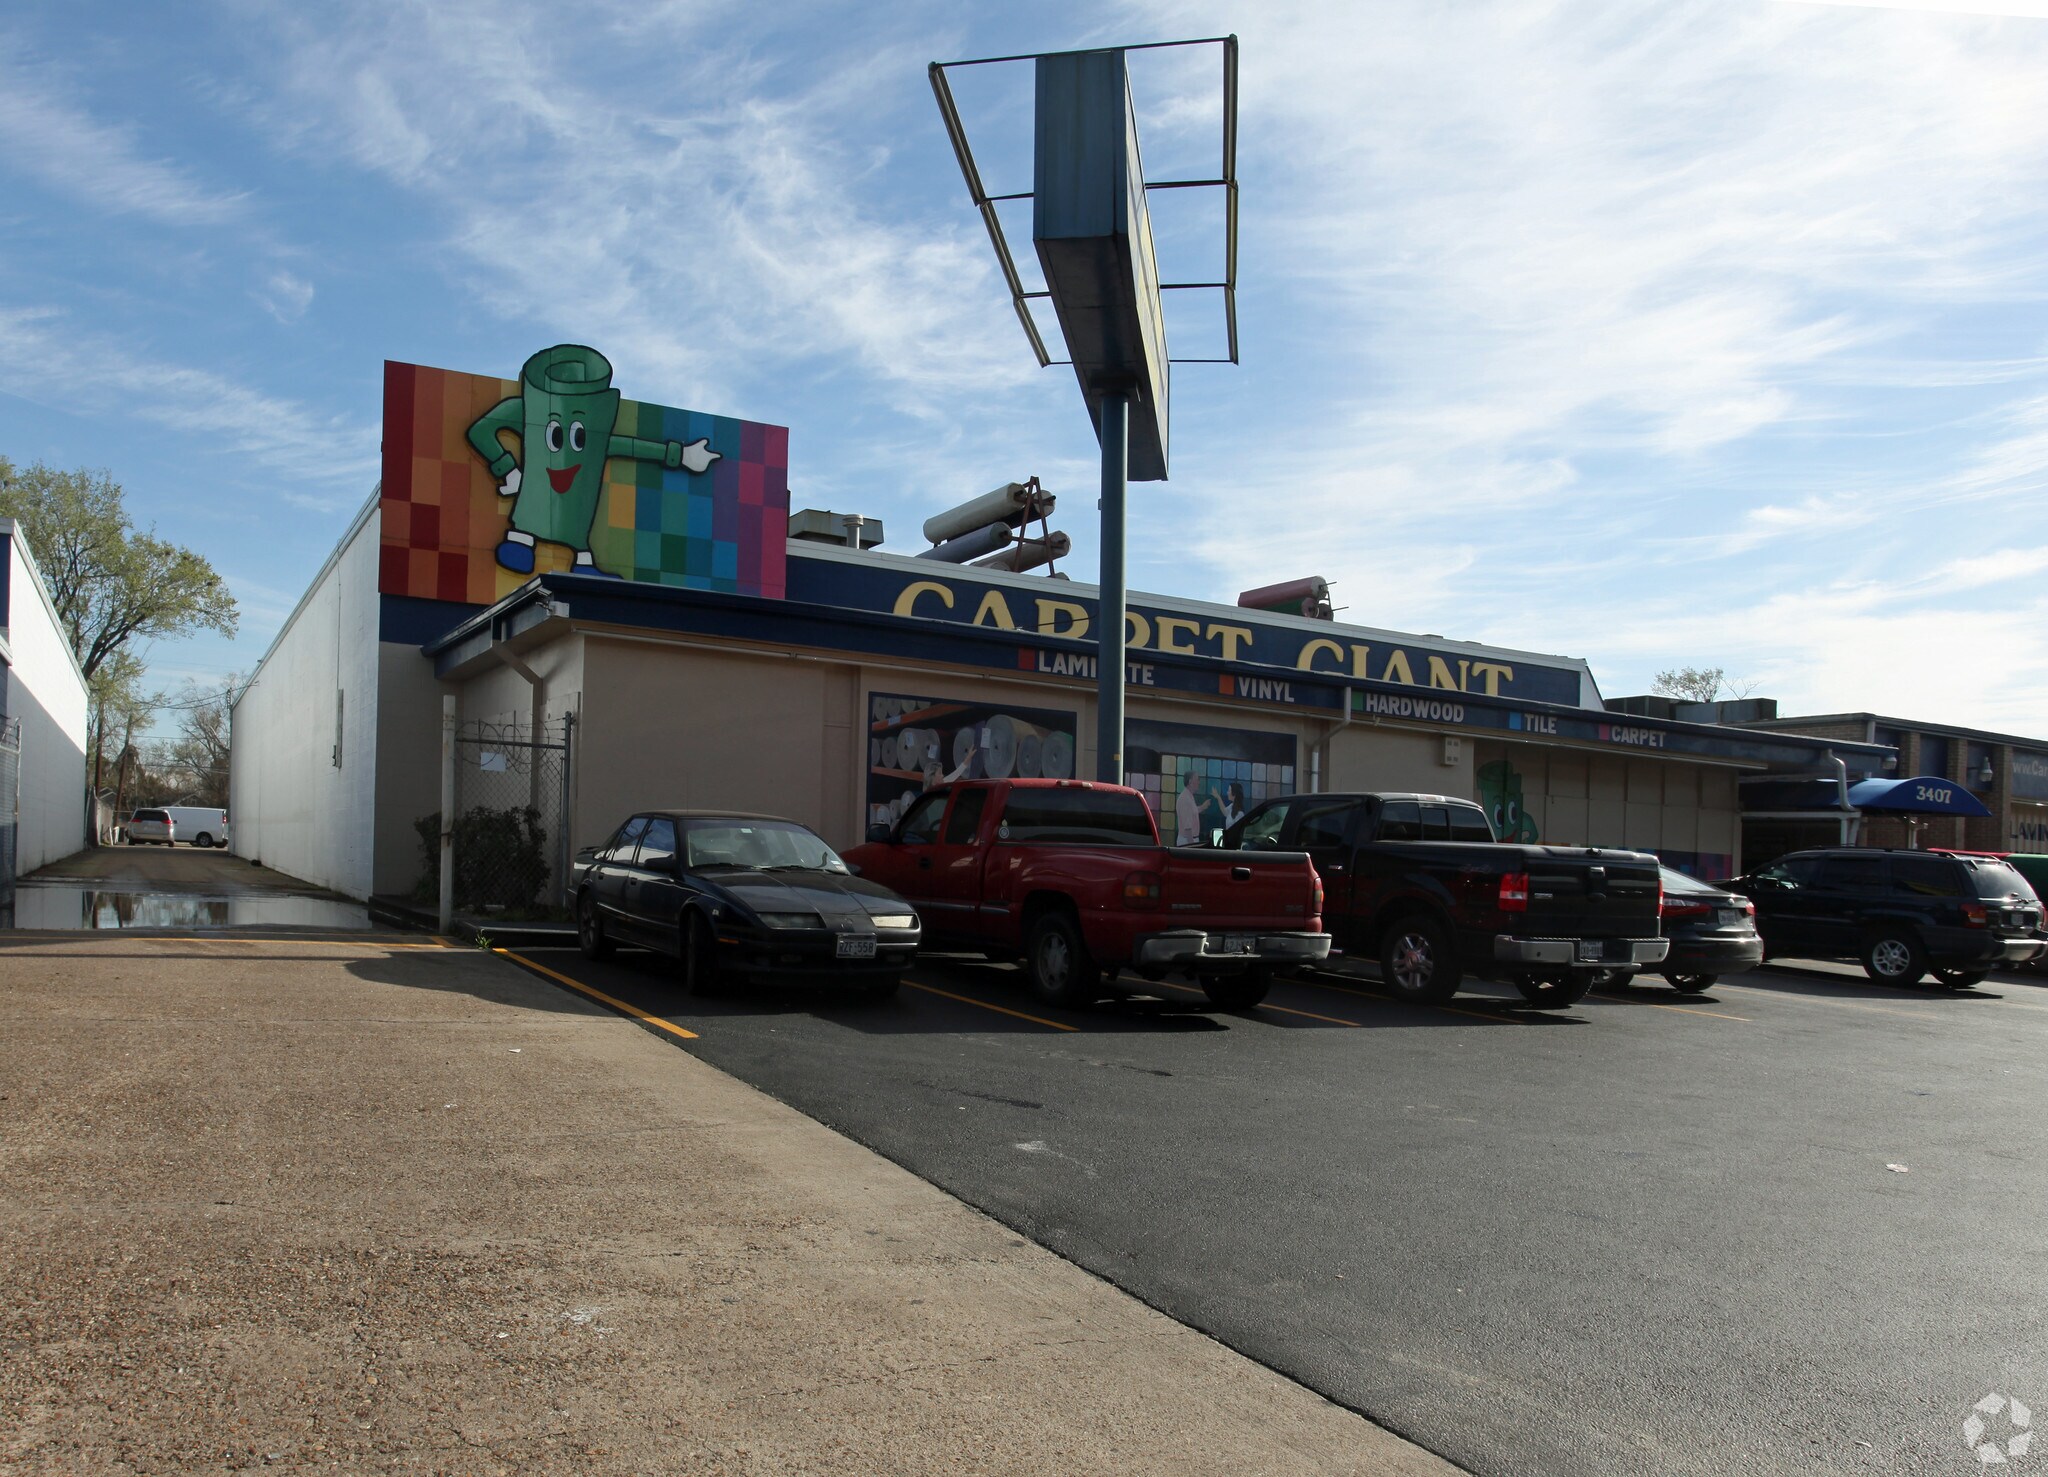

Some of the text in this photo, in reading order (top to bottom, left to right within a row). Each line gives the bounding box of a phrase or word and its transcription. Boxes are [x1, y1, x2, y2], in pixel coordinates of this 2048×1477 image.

[1296, 638, 1514, 697] GIANT
[1039, 650, 1667, 748] LAMITE VINYL HARDWOOD TILE CARPET
[1916, 785, 1952, 804] 3407
